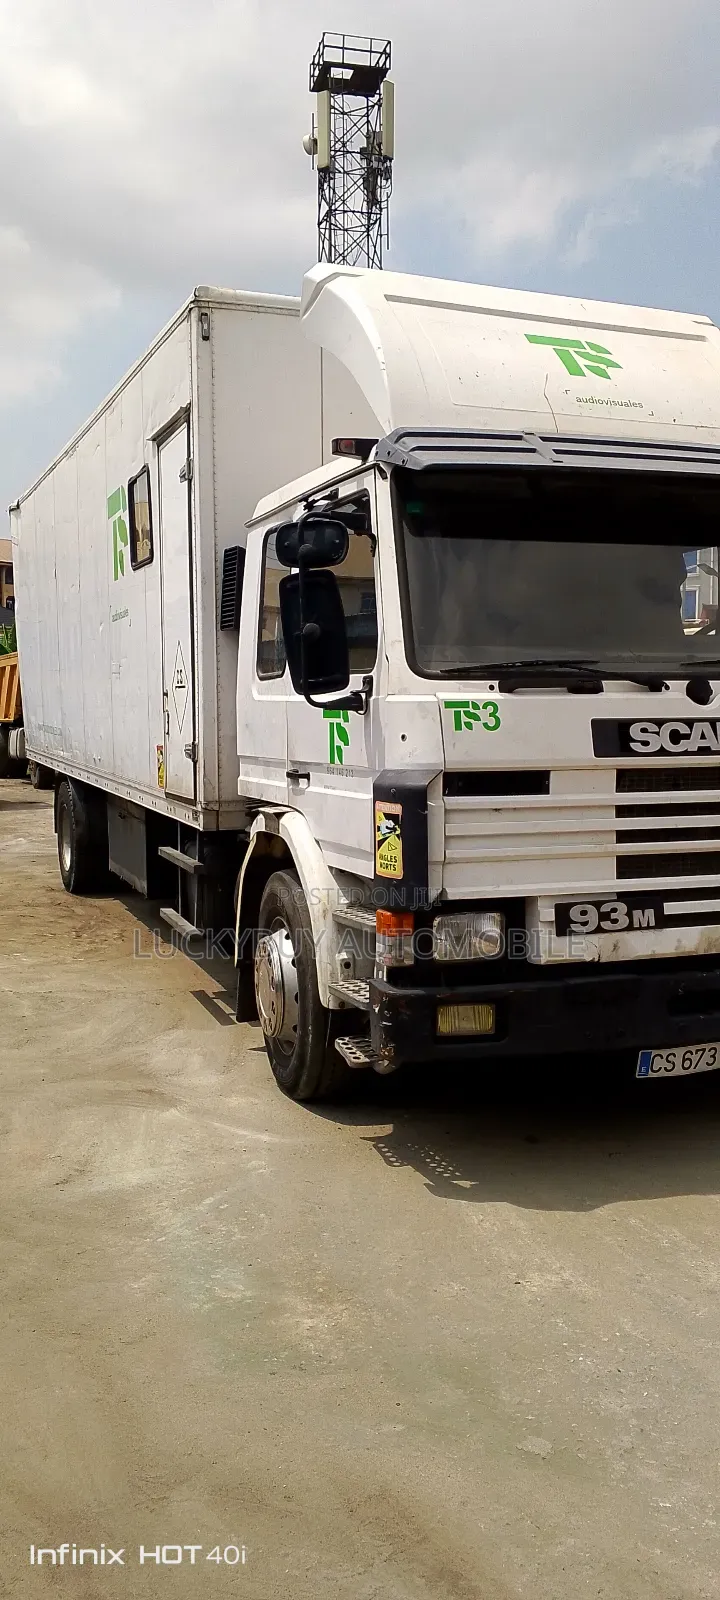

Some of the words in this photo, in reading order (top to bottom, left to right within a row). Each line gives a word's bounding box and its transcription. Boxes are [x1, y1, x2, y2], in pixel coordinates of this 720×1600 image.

[575, 395, 644, 409] audiovisuales
[629, 720, 720, 753] SCA
[650, 1052, 677, 1073] CS
[681, 1046, 718, 1070] 673
